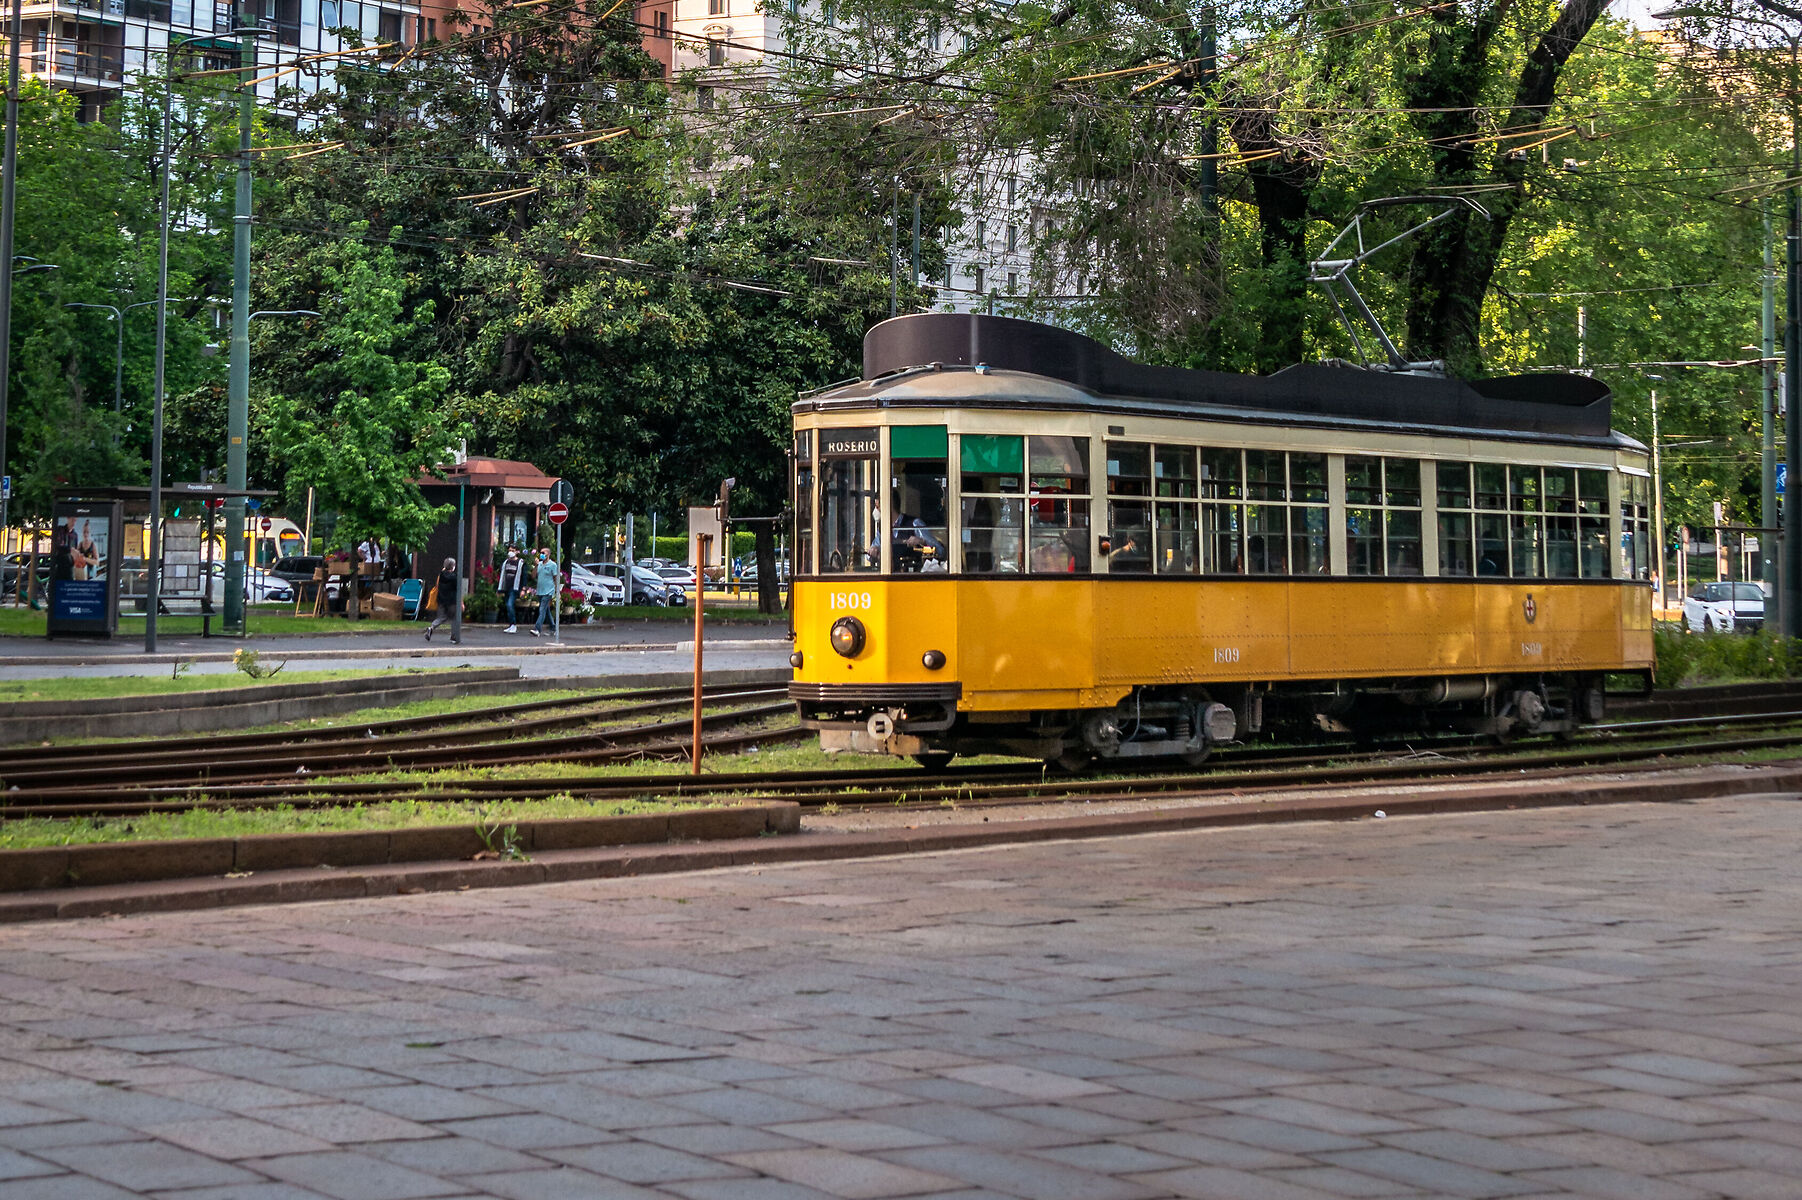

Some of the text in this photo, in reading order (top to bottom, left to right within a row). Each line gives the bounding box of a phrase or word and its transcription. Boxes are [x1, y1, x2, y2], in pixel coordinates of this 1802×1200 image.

[828, 440, 877, 452] ROSERIO
[830, 592, 872, 609] 1809
[1213, 647, 1240, 663] 1809
